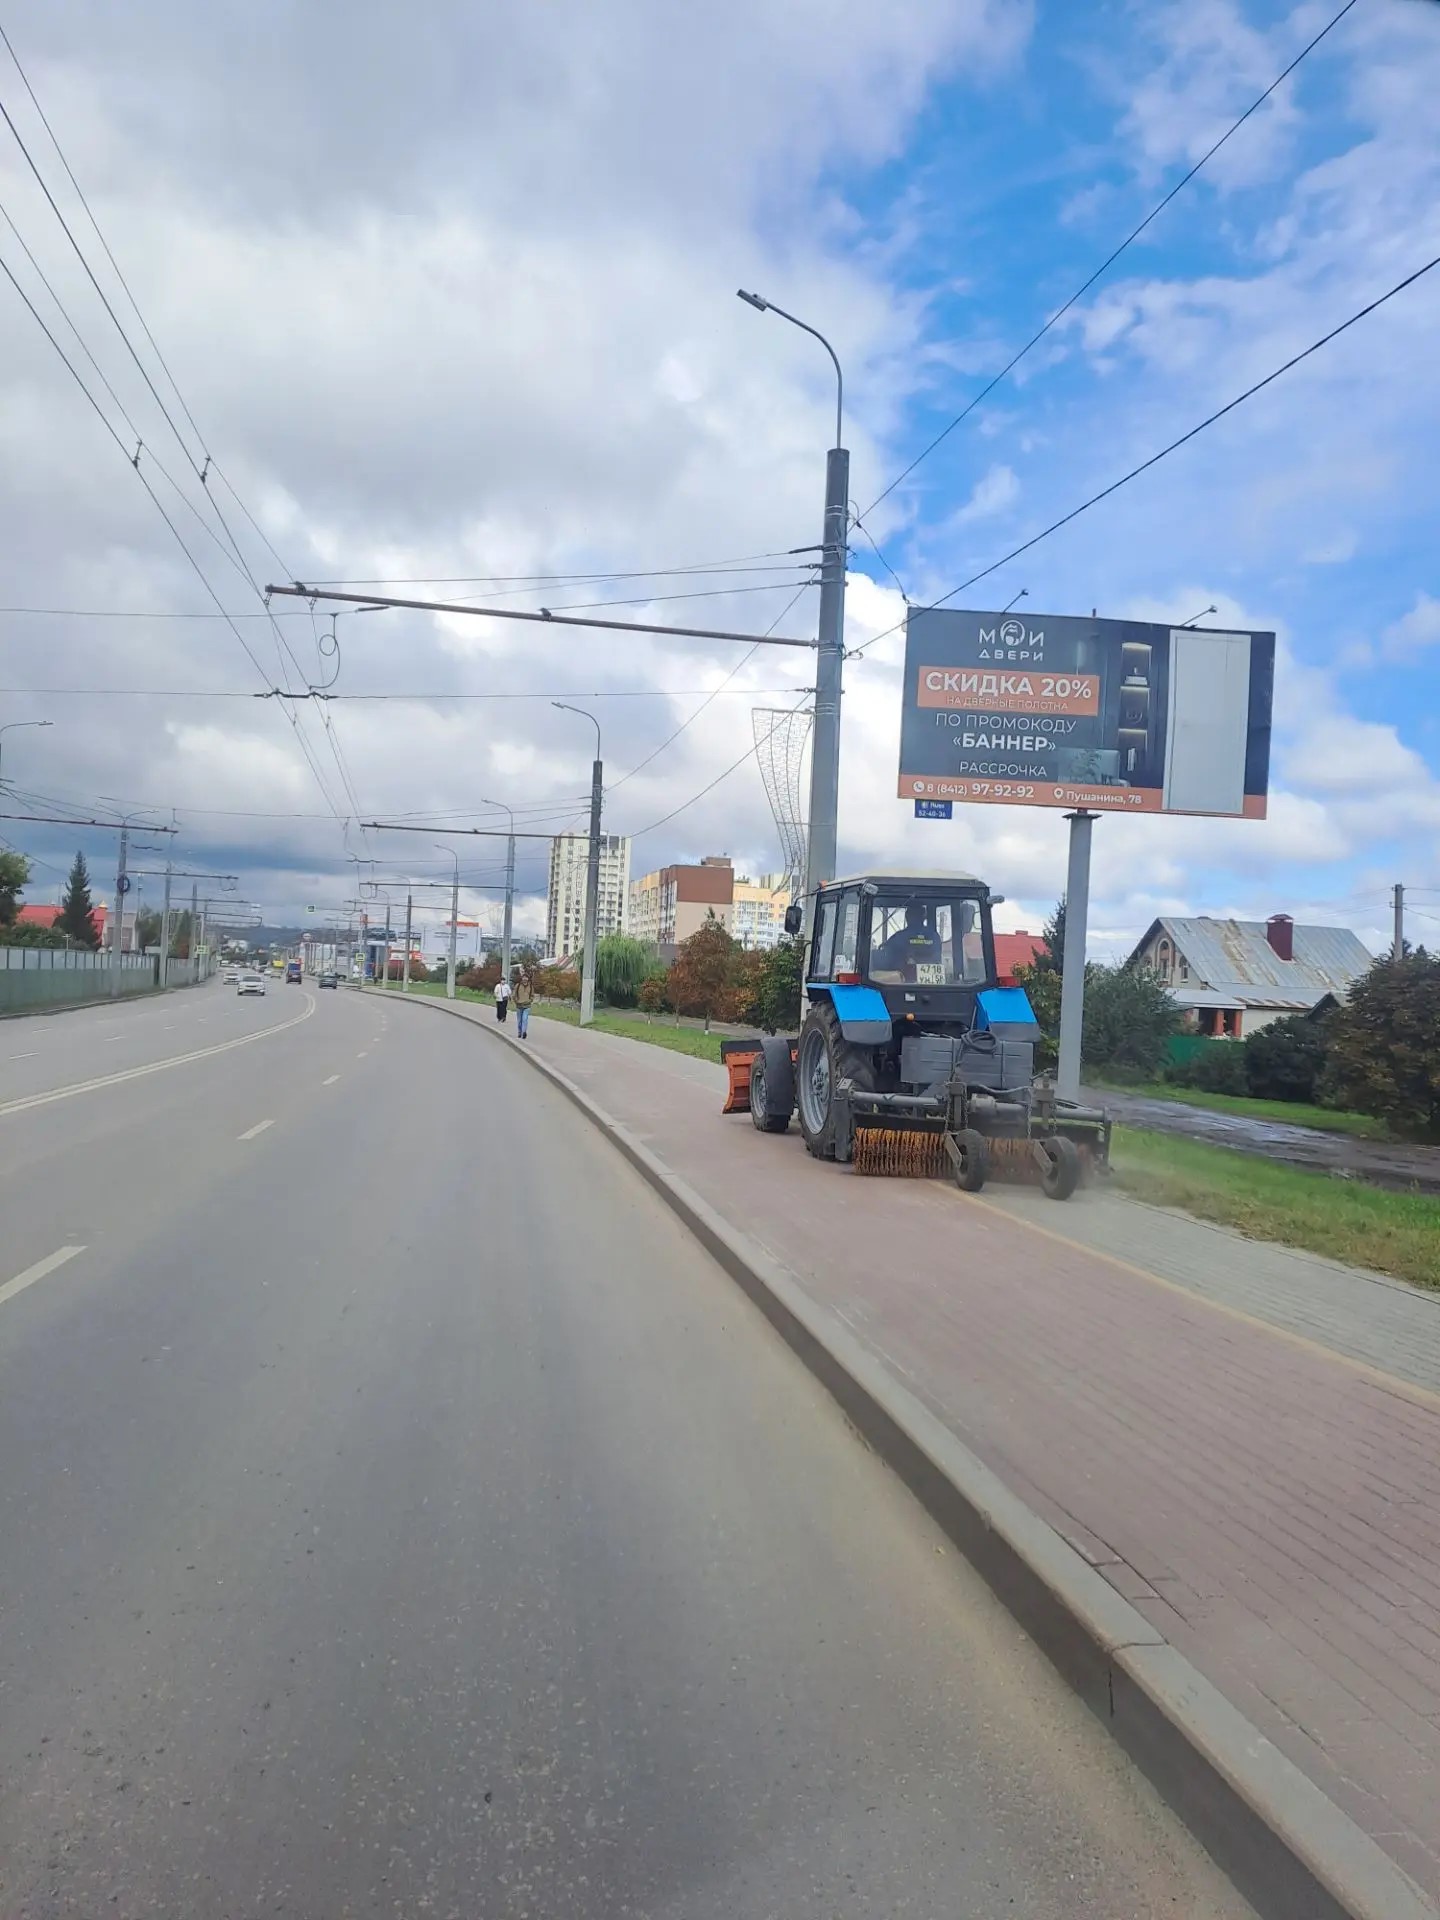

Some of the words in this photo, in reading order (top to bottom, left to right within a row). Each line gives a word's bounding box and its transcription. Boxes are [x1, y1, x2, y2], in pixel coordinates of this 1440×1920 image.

[978, 649, 1044, 662] ДВЕРИ
[926, 671, 1034, 697] СКИДКА
[1041, 677, 1092, 699] 20%
[947, 696, 961, 705] НА
[963, 697, 1013, 708] ДВЕРНЫЕ
[1017, 700, 1068, 711] ПОЛОТНА
[935, 713, 961, 727] ПО
[966, 714, 1077, 734] ПРОМОКОДУ
[952, 733, 1056, 752] «БАННЕР»
[959, 761, 1047, 777] РАССРОЧКА
[927, 783, 934, 792] 8
[937, 783, 968, 796] (8412)
[972, 783, 1034, 799] 97-92-92
[1066, 790, 1127, 804] Пушанина,
[1128, 794, 1142, 804] 78
